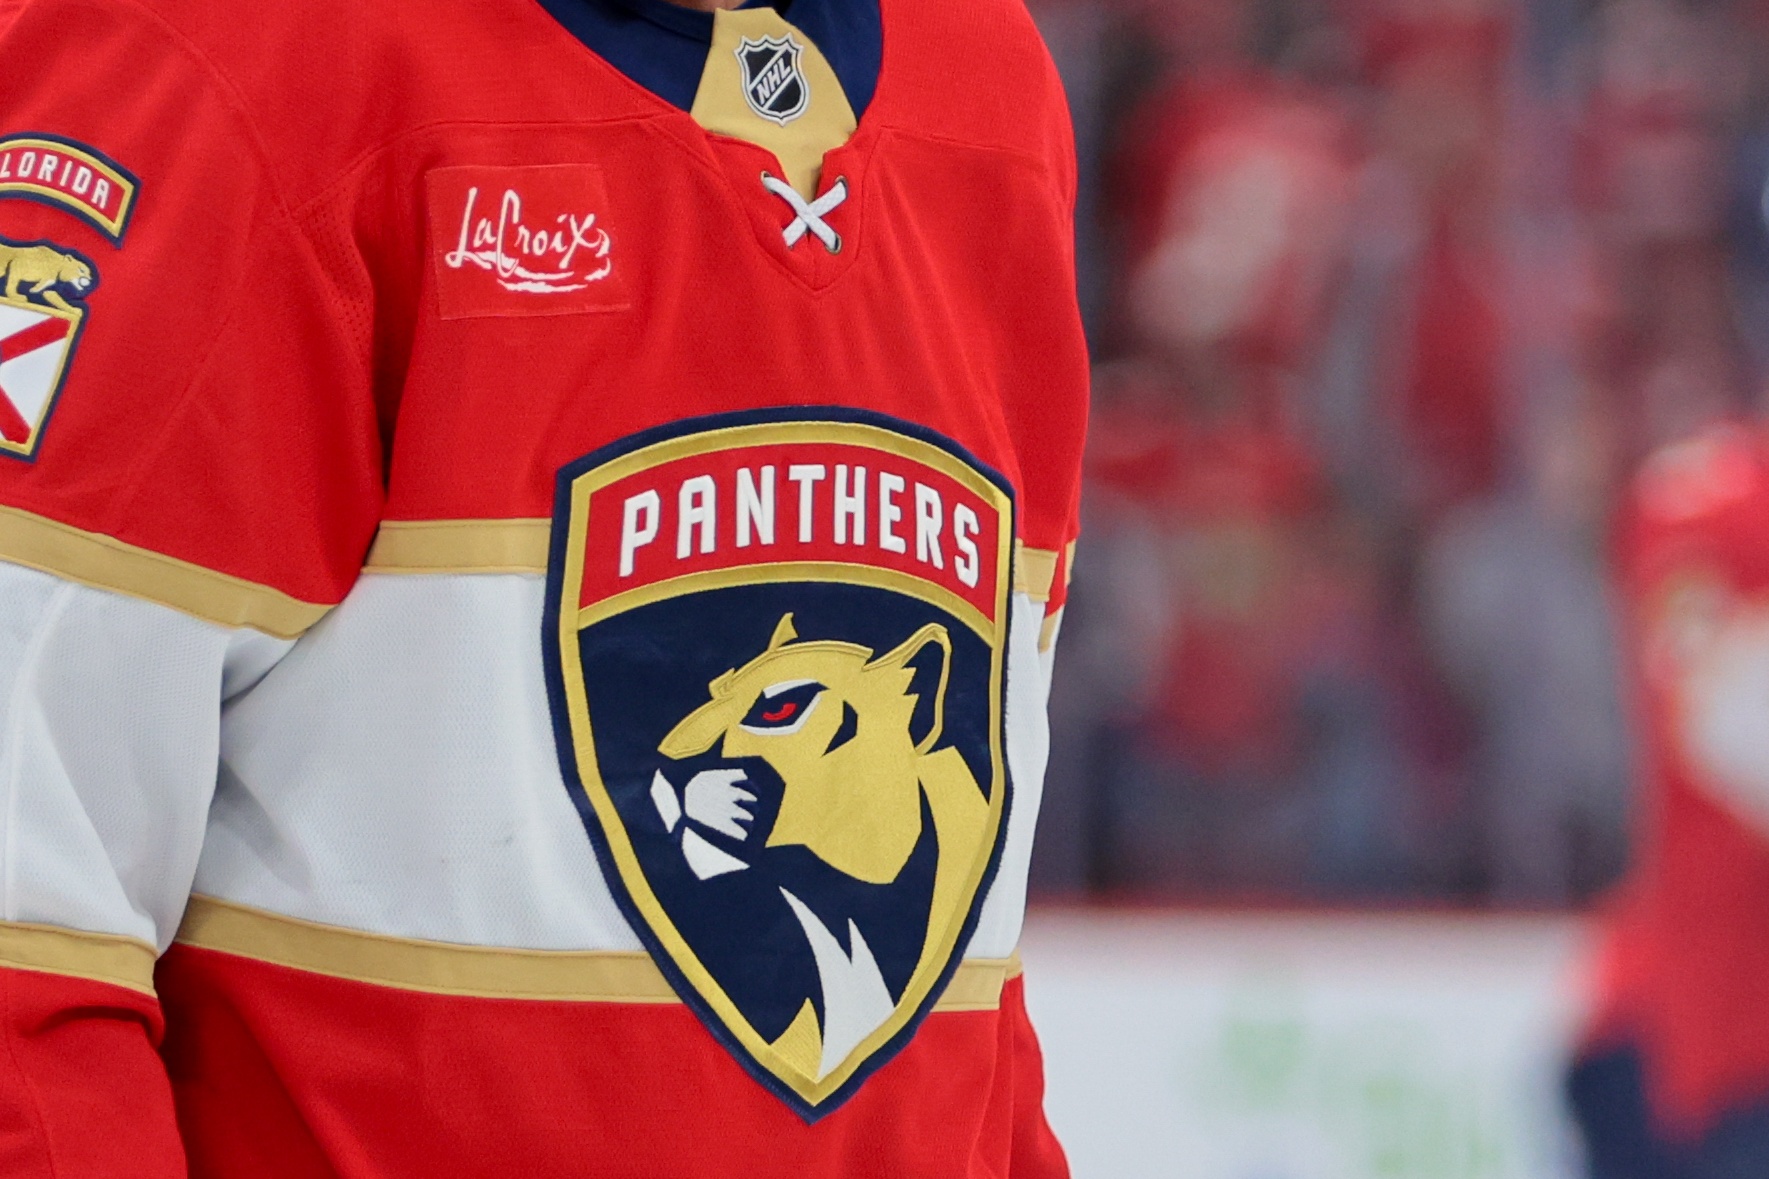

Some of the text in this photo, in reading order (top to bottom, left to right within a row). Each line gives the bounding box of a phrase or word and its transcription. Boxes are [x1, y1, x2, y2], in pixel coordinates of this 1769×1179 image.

[756, 57, 791, 106] NHL
[445, 186, 605, 278] LaCroix
[618, 463, 981, 589] PANTHERS
